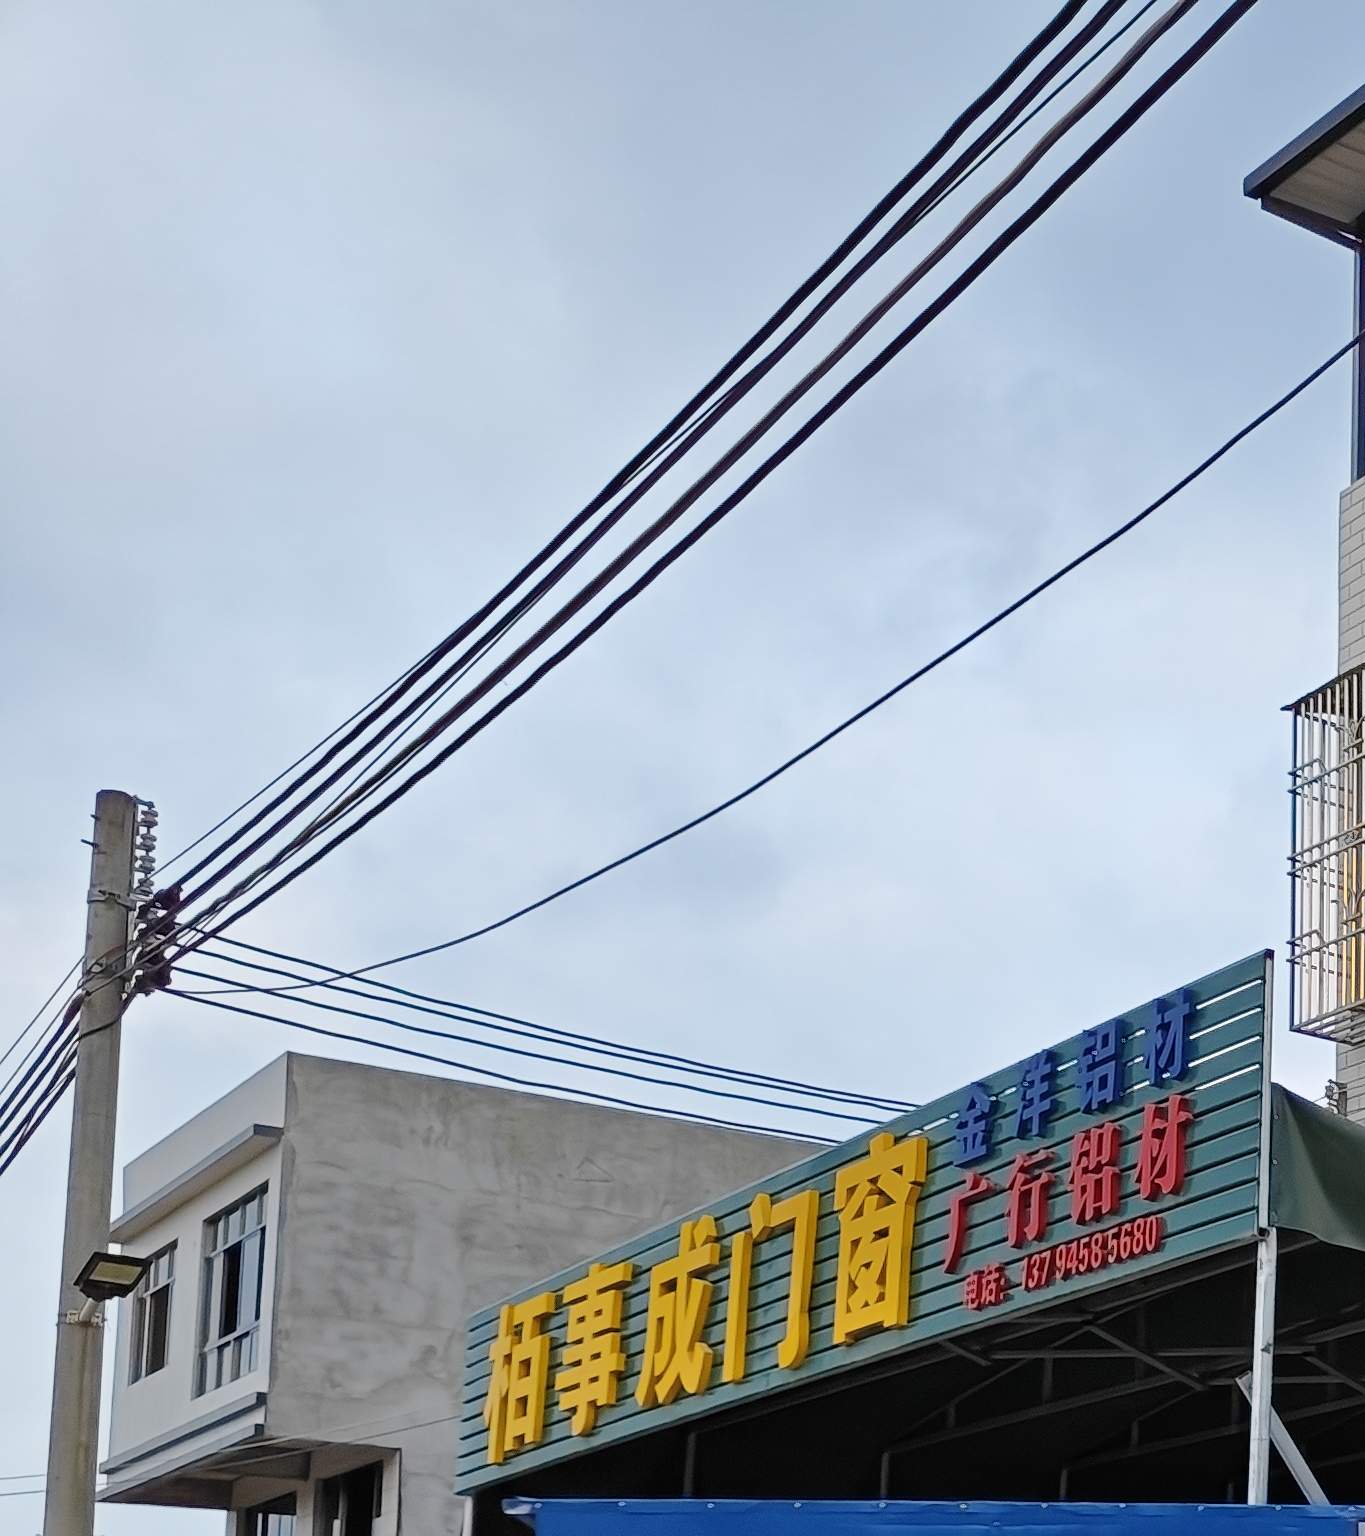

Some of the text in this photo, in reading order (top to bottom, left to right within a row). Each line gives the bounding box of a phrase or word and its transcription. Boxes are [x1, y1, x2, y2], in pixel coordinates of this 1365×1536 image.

[952, 987, 1193, 1167] 金洋铝材
[944, 1093, 1194, 1274] 广行铝材
